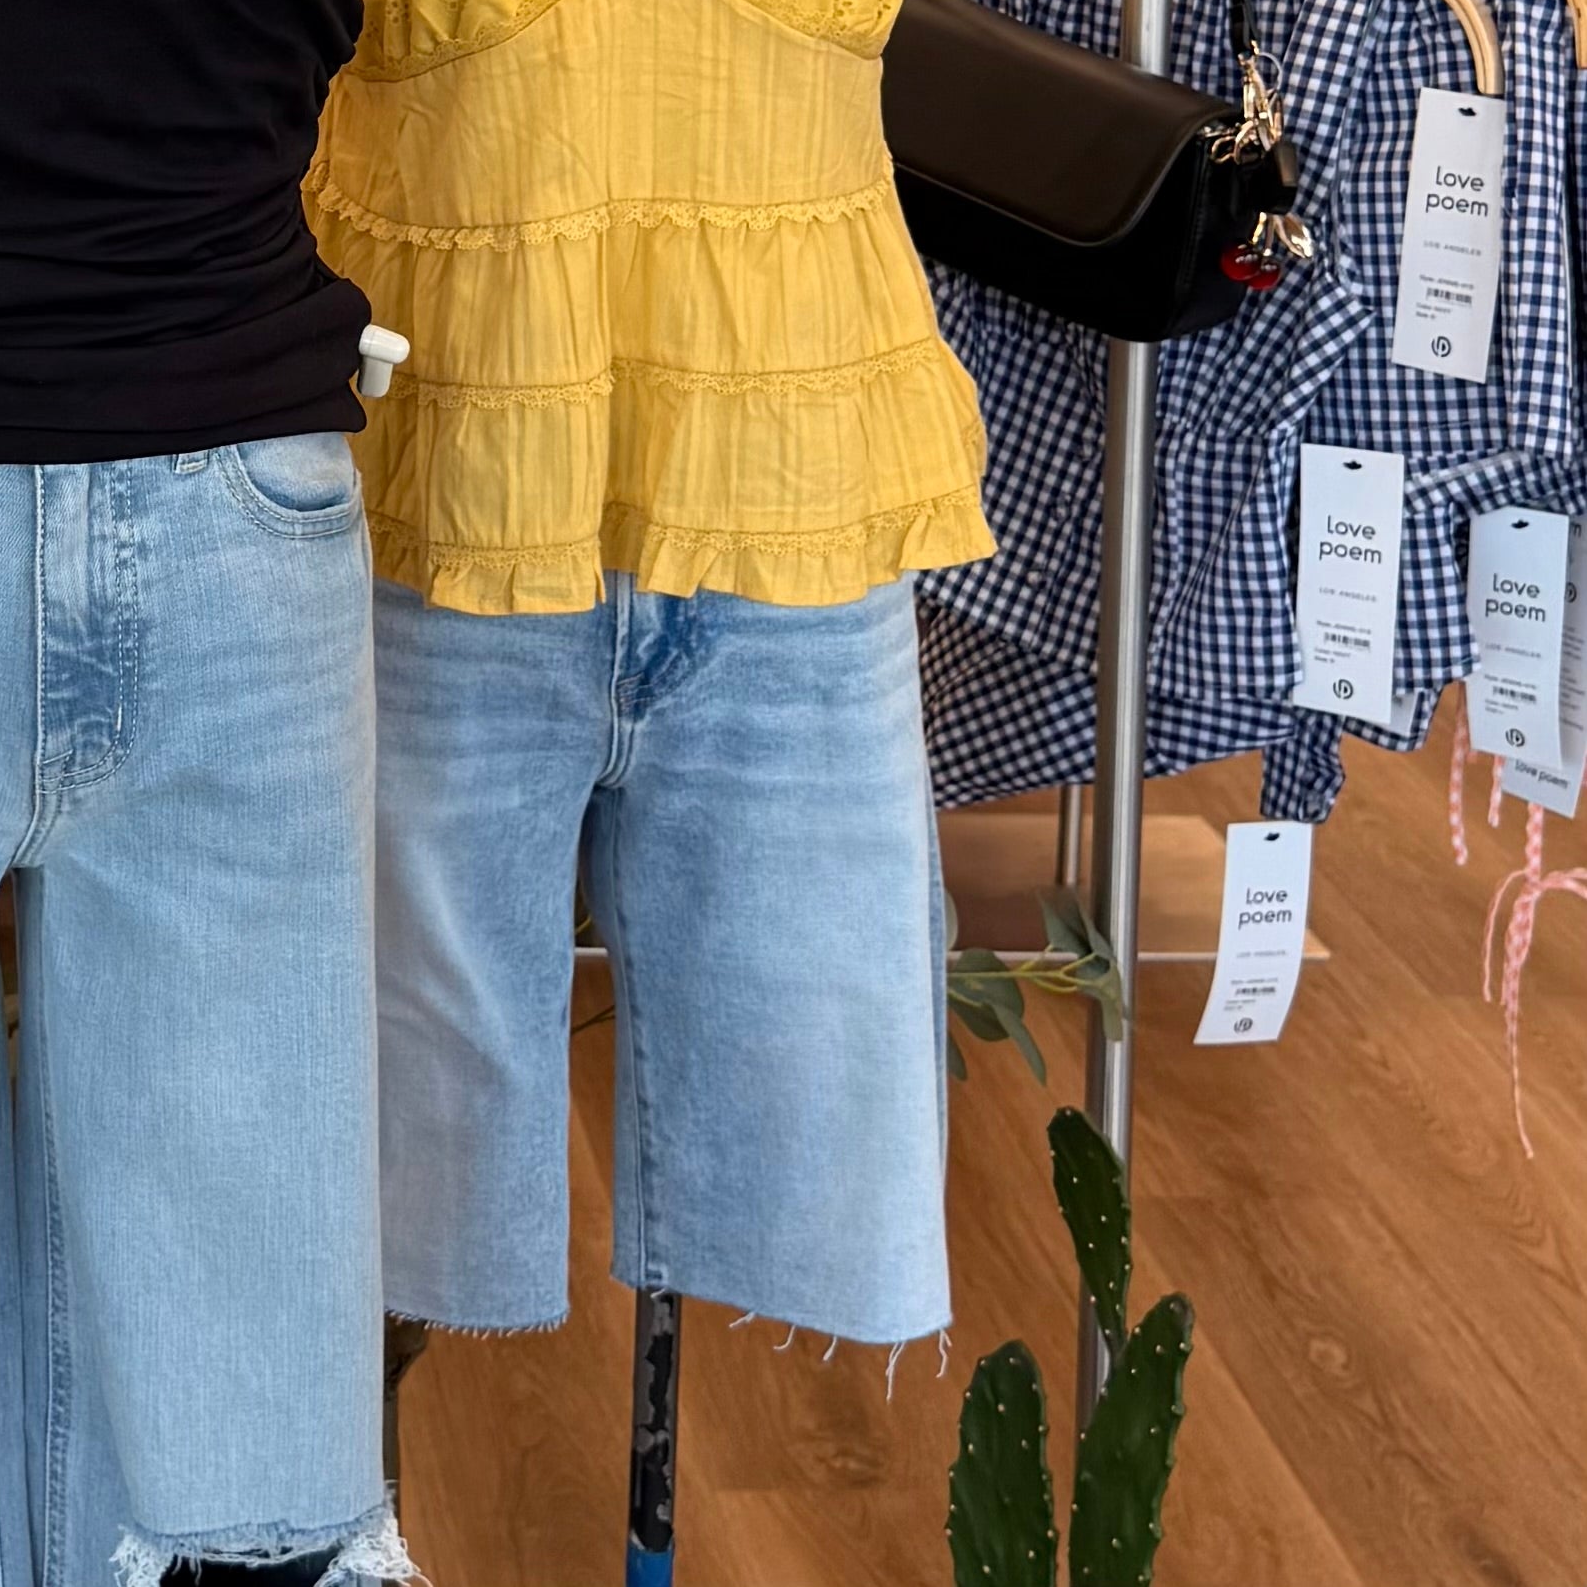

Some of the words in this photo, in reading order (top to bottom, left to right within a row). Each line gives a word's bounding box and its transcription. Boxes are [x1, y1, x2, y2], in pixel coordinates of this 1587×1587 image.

[1425, 192, 1488, 217] poem
[1319, 541, 1382, 564] poem
[1485, 598, 1546, 623] poem
[1238, 909, 1293, 931] poem
